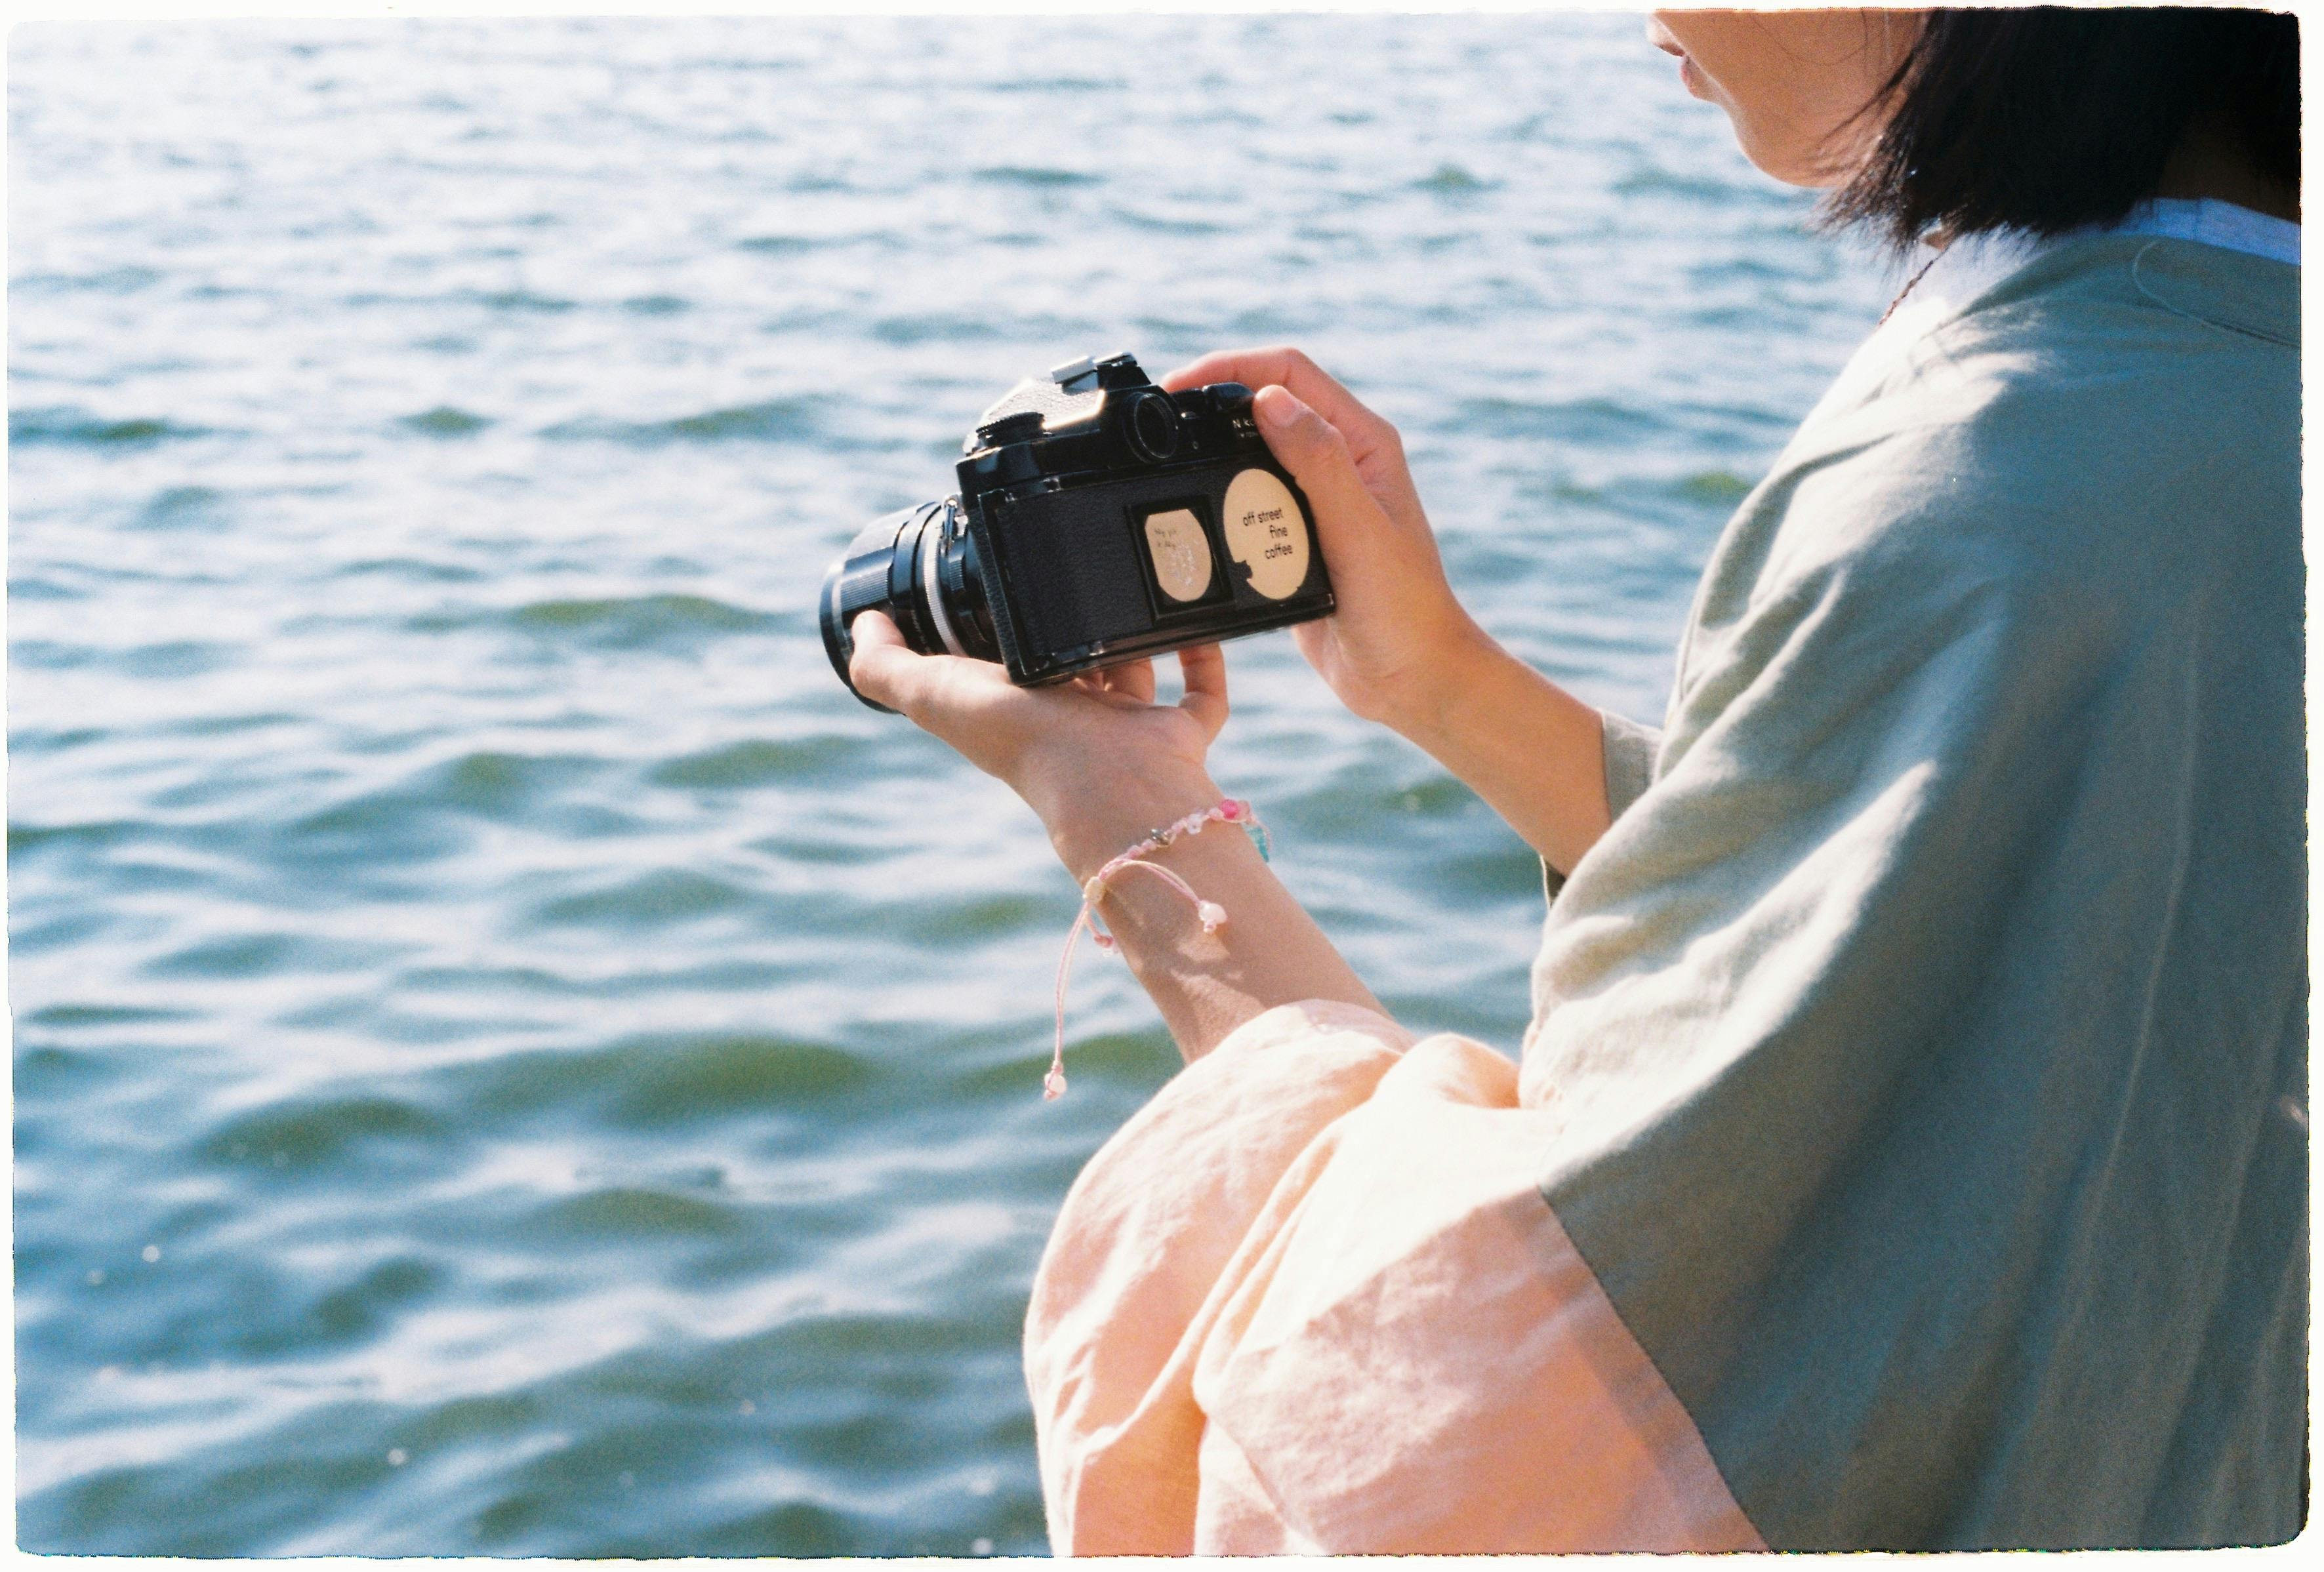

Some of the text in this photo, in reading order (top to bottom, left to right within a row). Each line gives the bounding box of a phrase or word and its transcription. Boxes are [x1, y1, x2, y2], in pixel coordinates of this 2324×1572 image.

[1243, 507, 1284, 526] off street
[1269, 525, 1288, 538] fine
[1265, 543, 1293, 559] coffee
